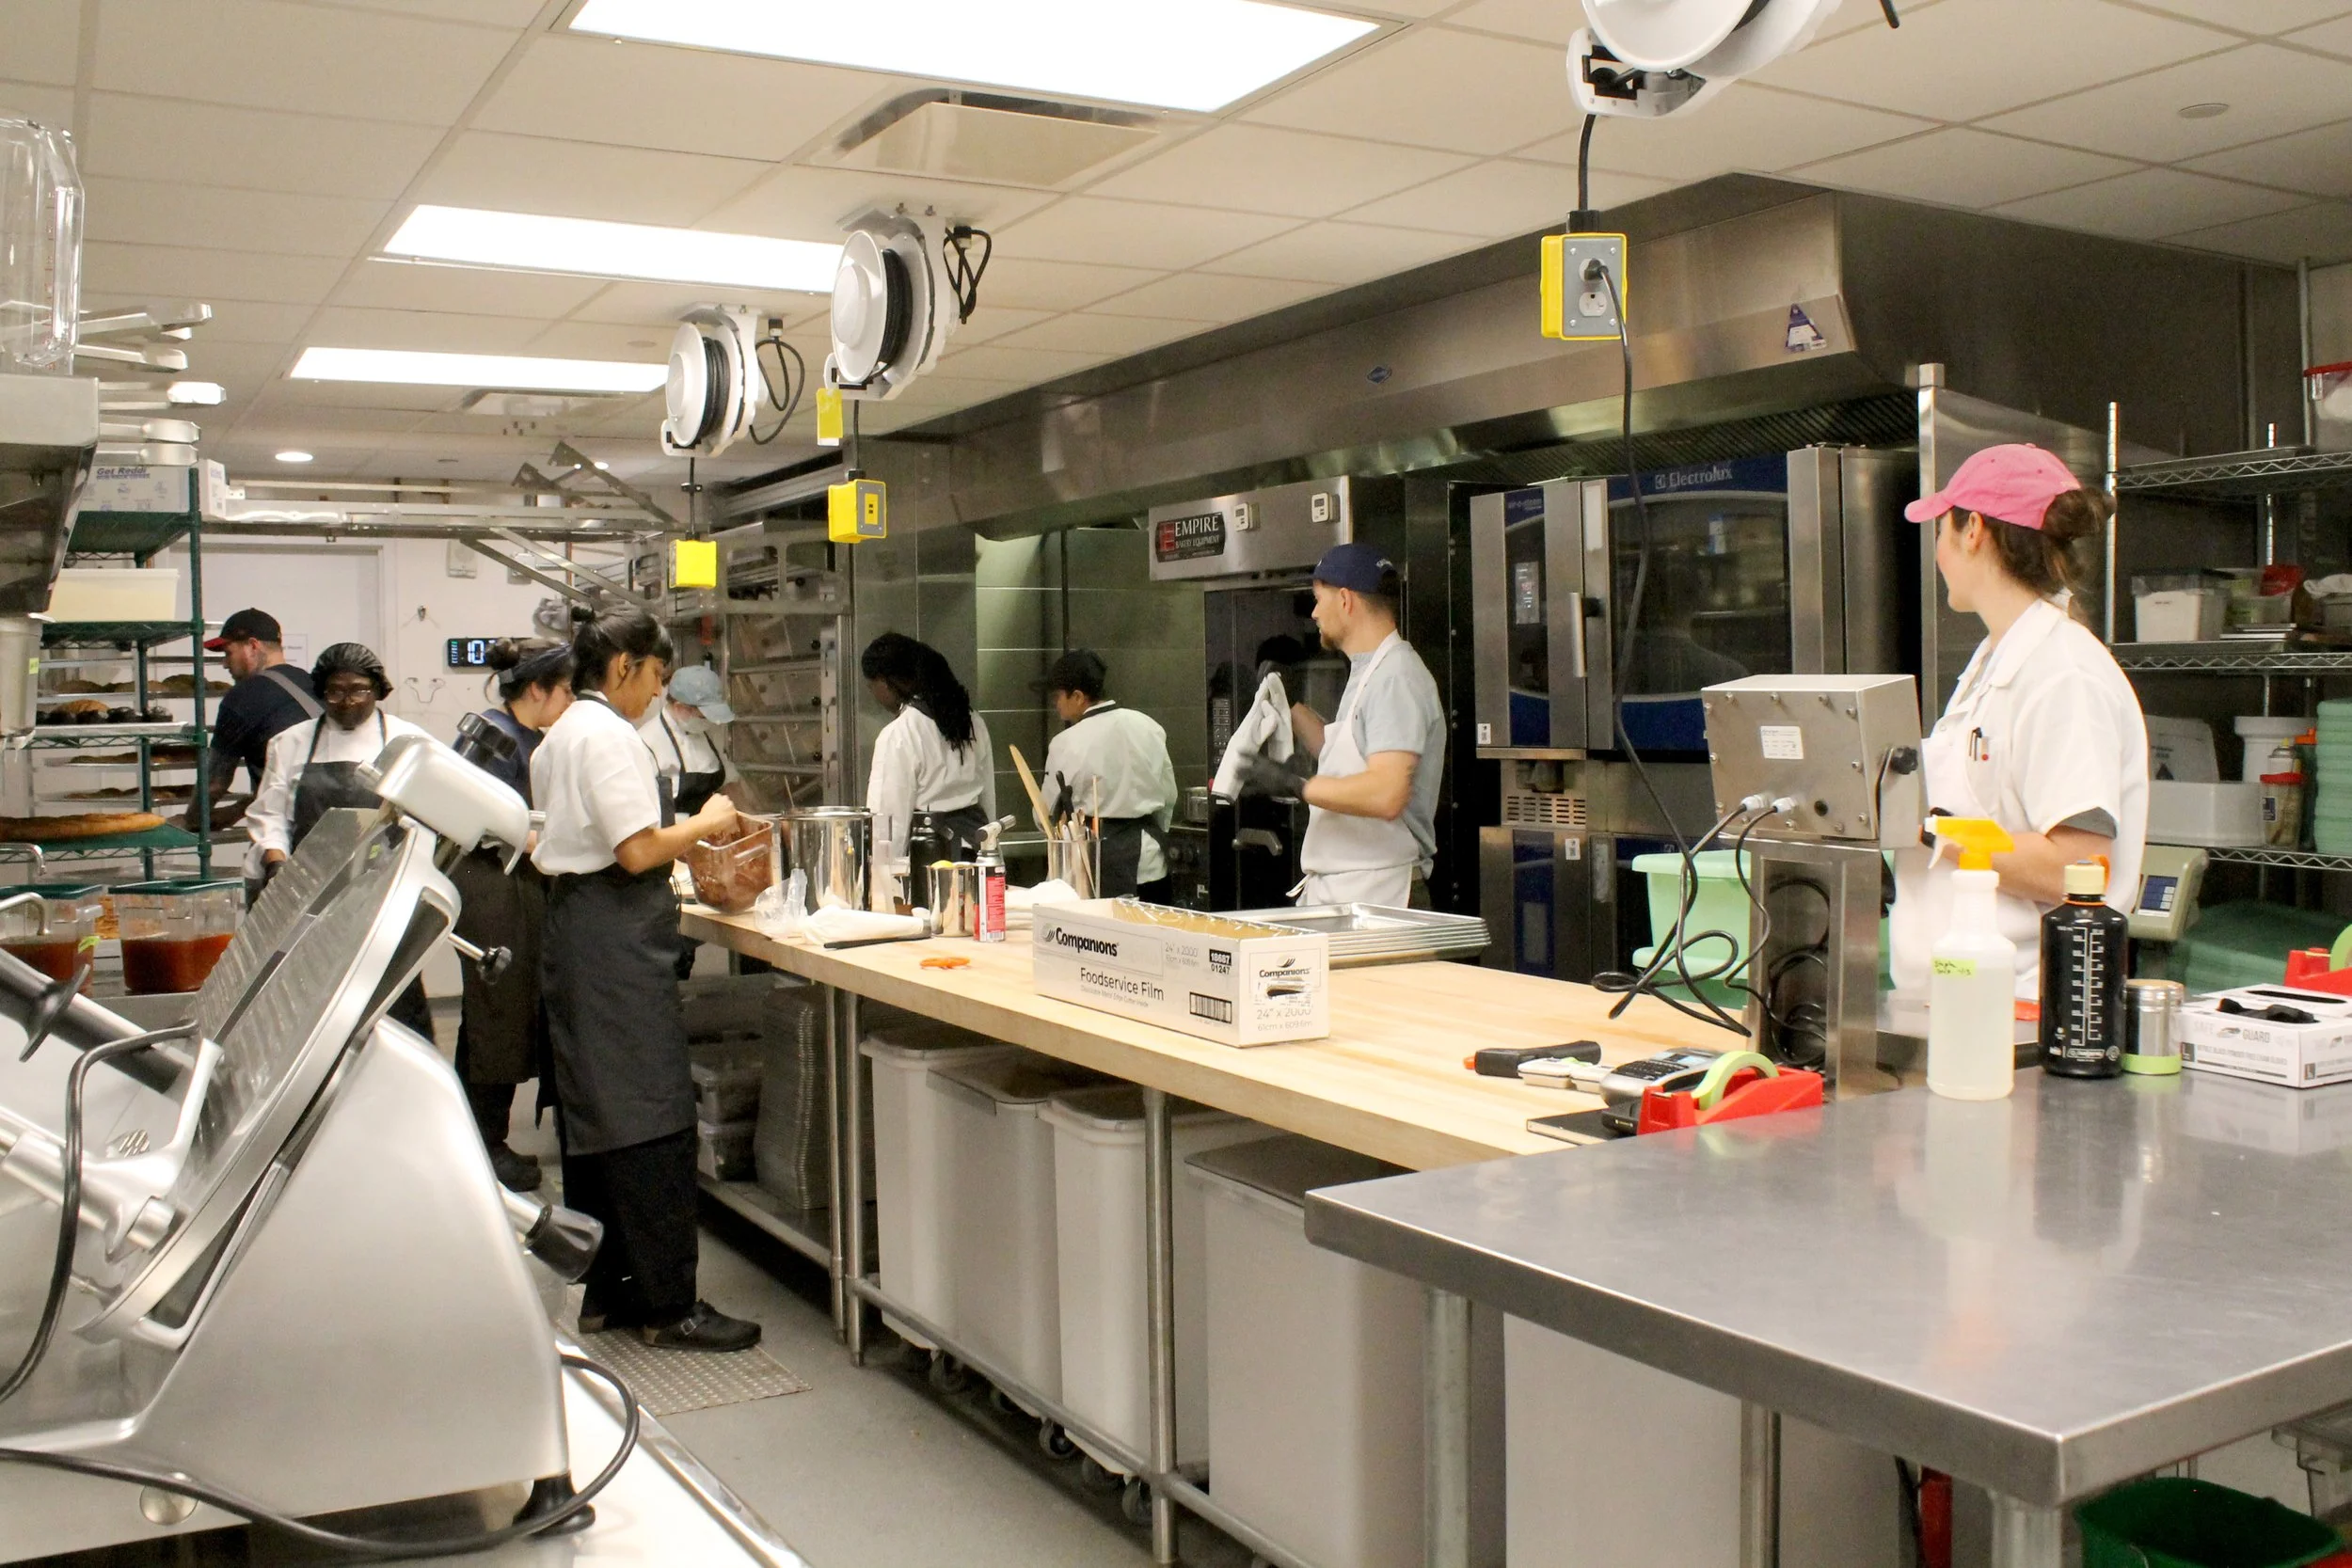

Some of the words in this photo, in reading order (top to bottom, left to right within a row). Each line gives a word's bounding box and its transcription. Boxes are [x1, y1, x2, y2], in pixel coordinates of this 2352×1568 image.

[1668, 467, 1733, 489] Electrolux
[1175, 515, 1219, 537] EMPIRE
[1175, 539, 1192, 549] BAKERY
[1192, 534, 1220, 547] EQUIPMENT
[1056, 927, 1118, 957] Companions
[1211, 963, 1231, 974] 01247
[1259, 968, 1310, 978] Companions
[1080, 967, 1138, 994] Foodservice
[1141, 981, 1165, 1001] Film
[2242, 1028, 2270, 1043] GUARD
